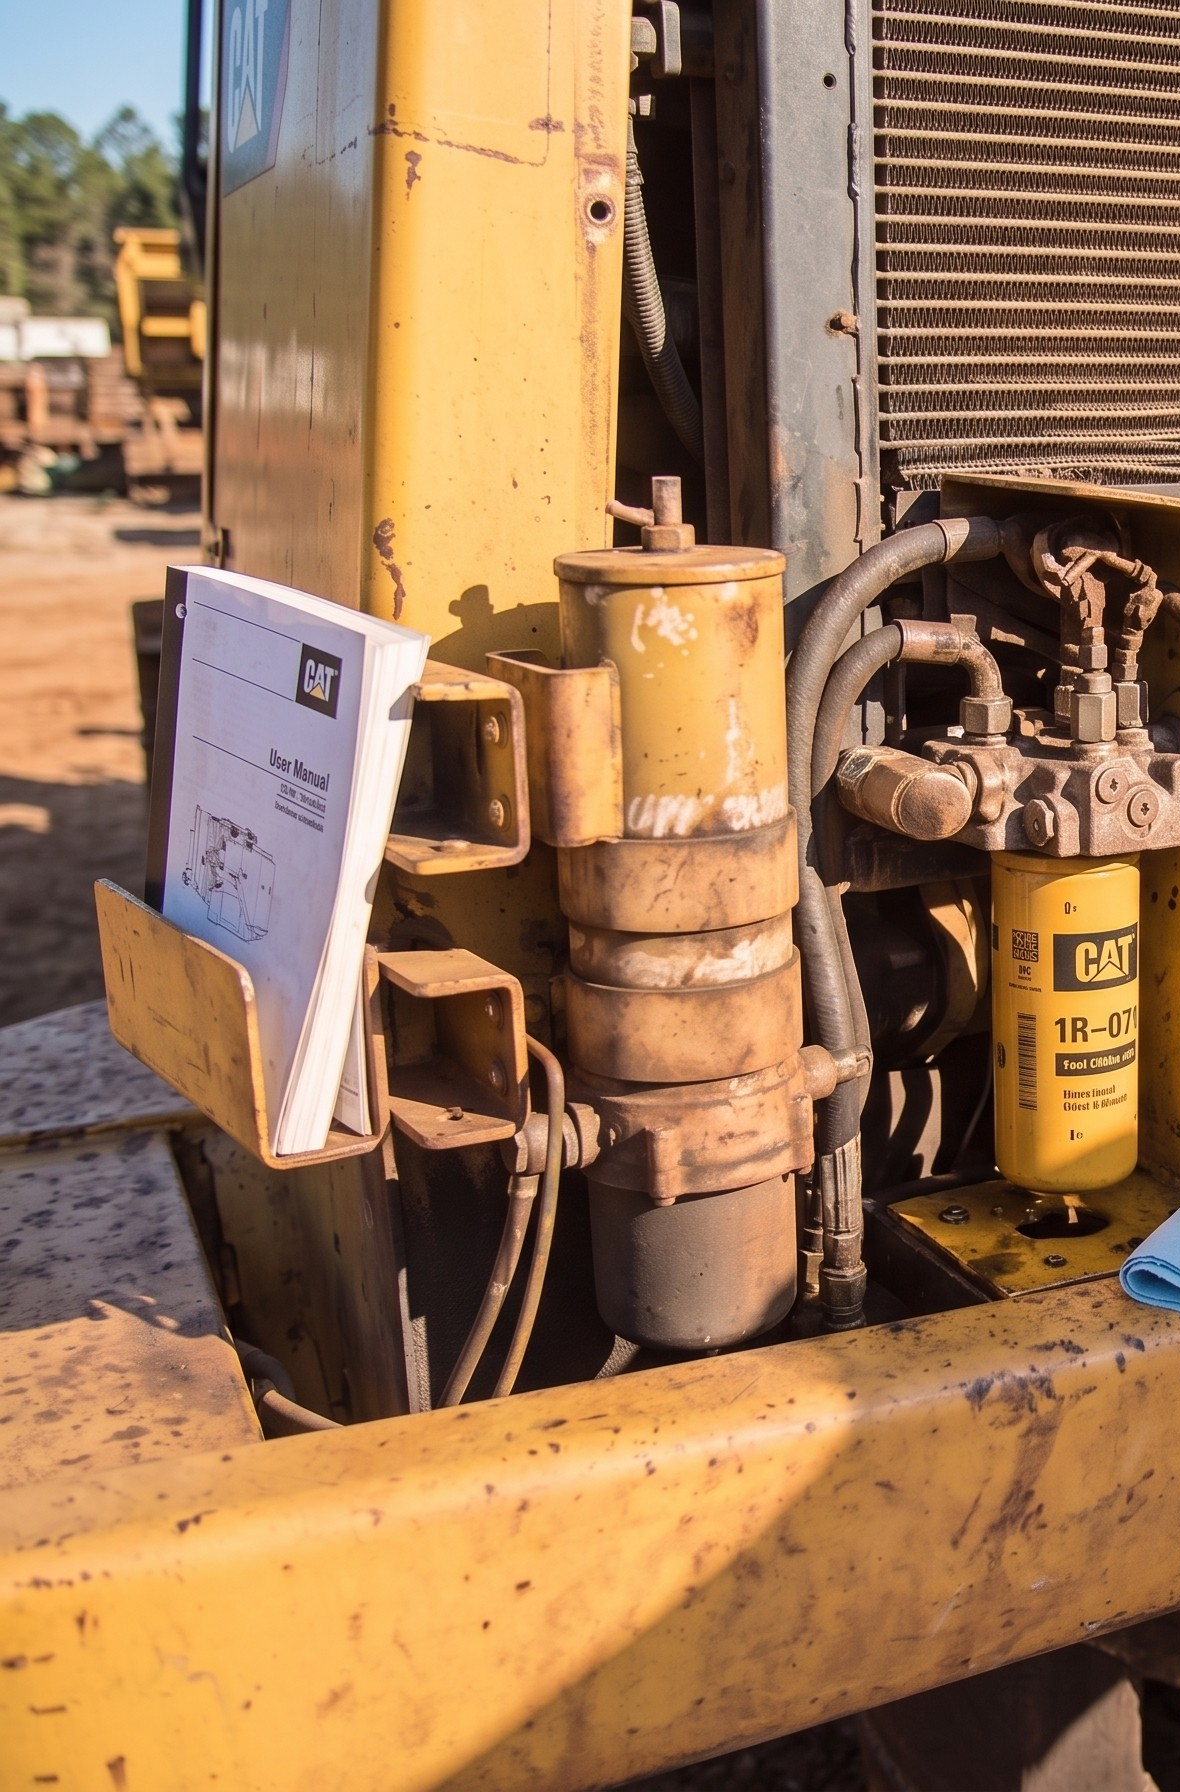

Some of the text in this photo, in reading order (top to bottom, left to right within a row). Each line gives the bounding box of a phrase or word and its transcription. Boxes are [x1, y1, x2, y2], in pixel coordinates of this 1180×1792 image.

[227, 0, 268, 153] CAT
[303, 659, 335, 702] CAT
[269, 748, 330, 792] User Manual
[1075, 934, 1133, 983] CAT
